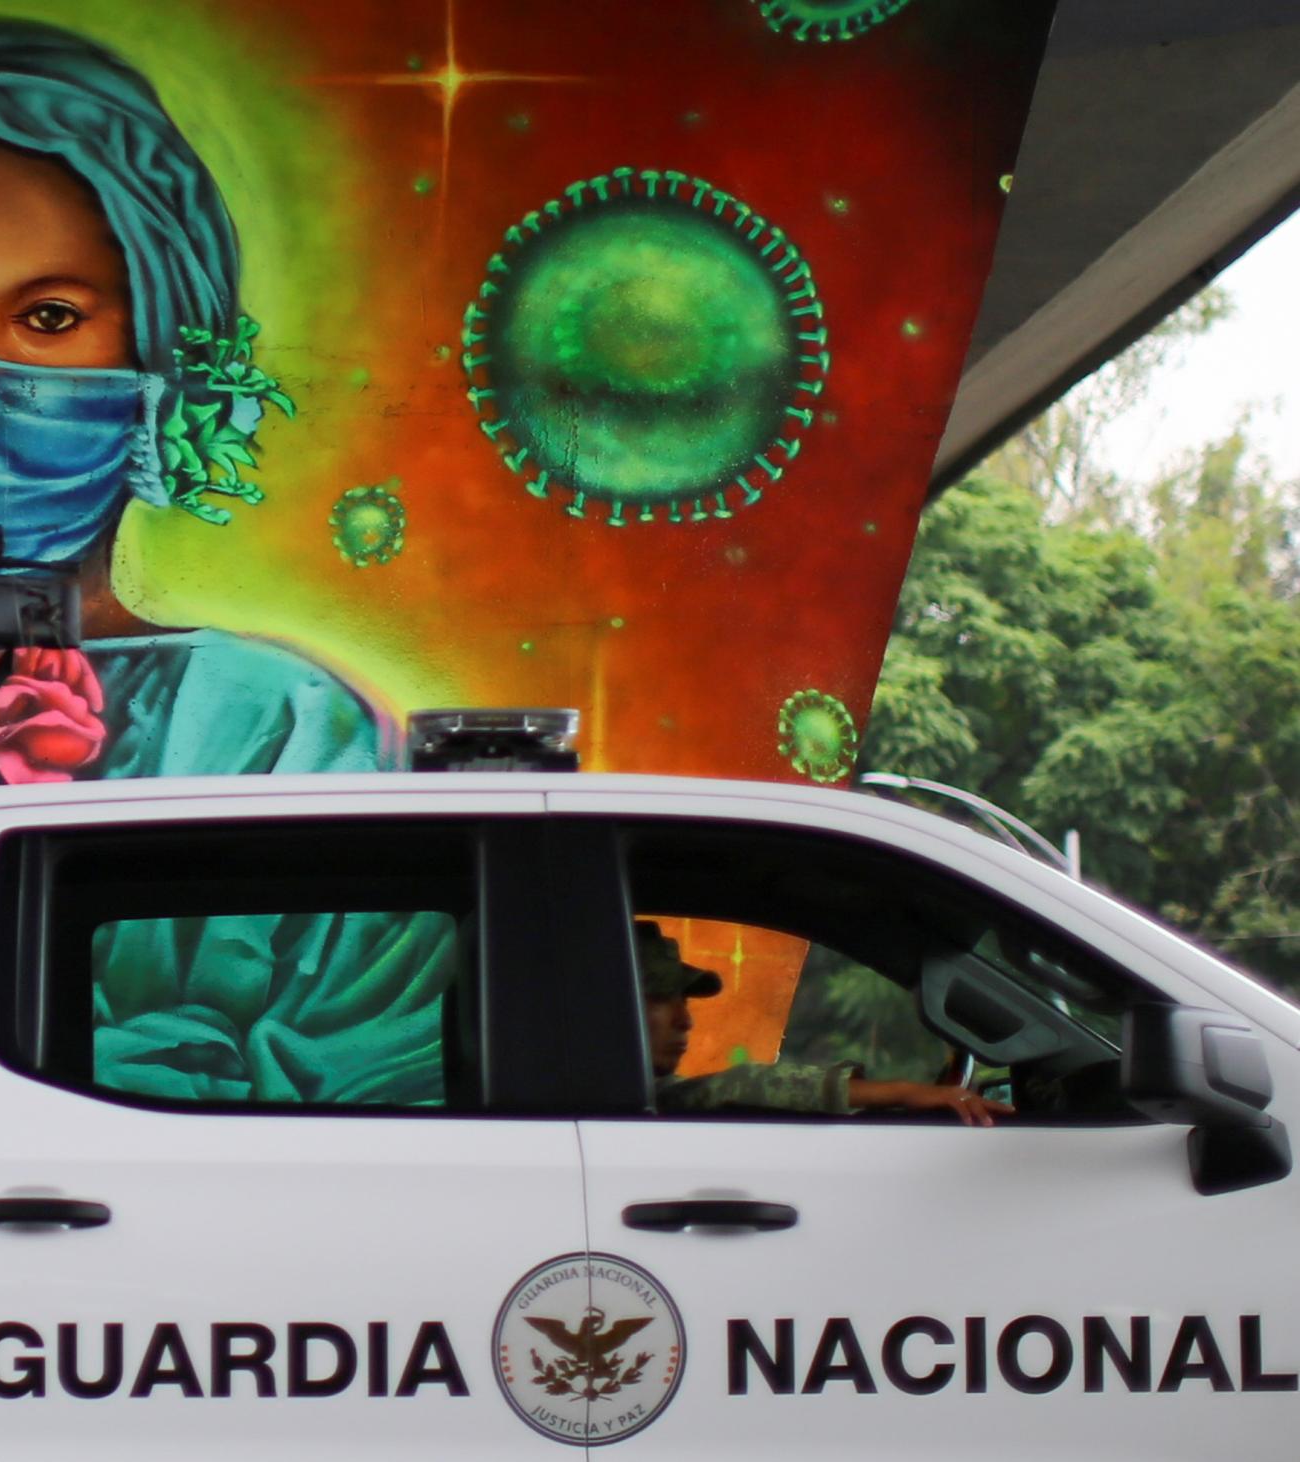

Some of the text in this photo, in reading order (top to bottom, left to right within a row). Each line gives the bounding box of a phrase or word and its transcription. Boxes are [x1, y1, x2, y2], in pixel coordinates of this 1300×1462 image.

[518, 1266, 657, 1309] GUARDIA NACIONAL
[728, 1315, 1299, 1395] NACIONAL
[531, 1403, 646, 1434] JUSTICIA Y PAZ
